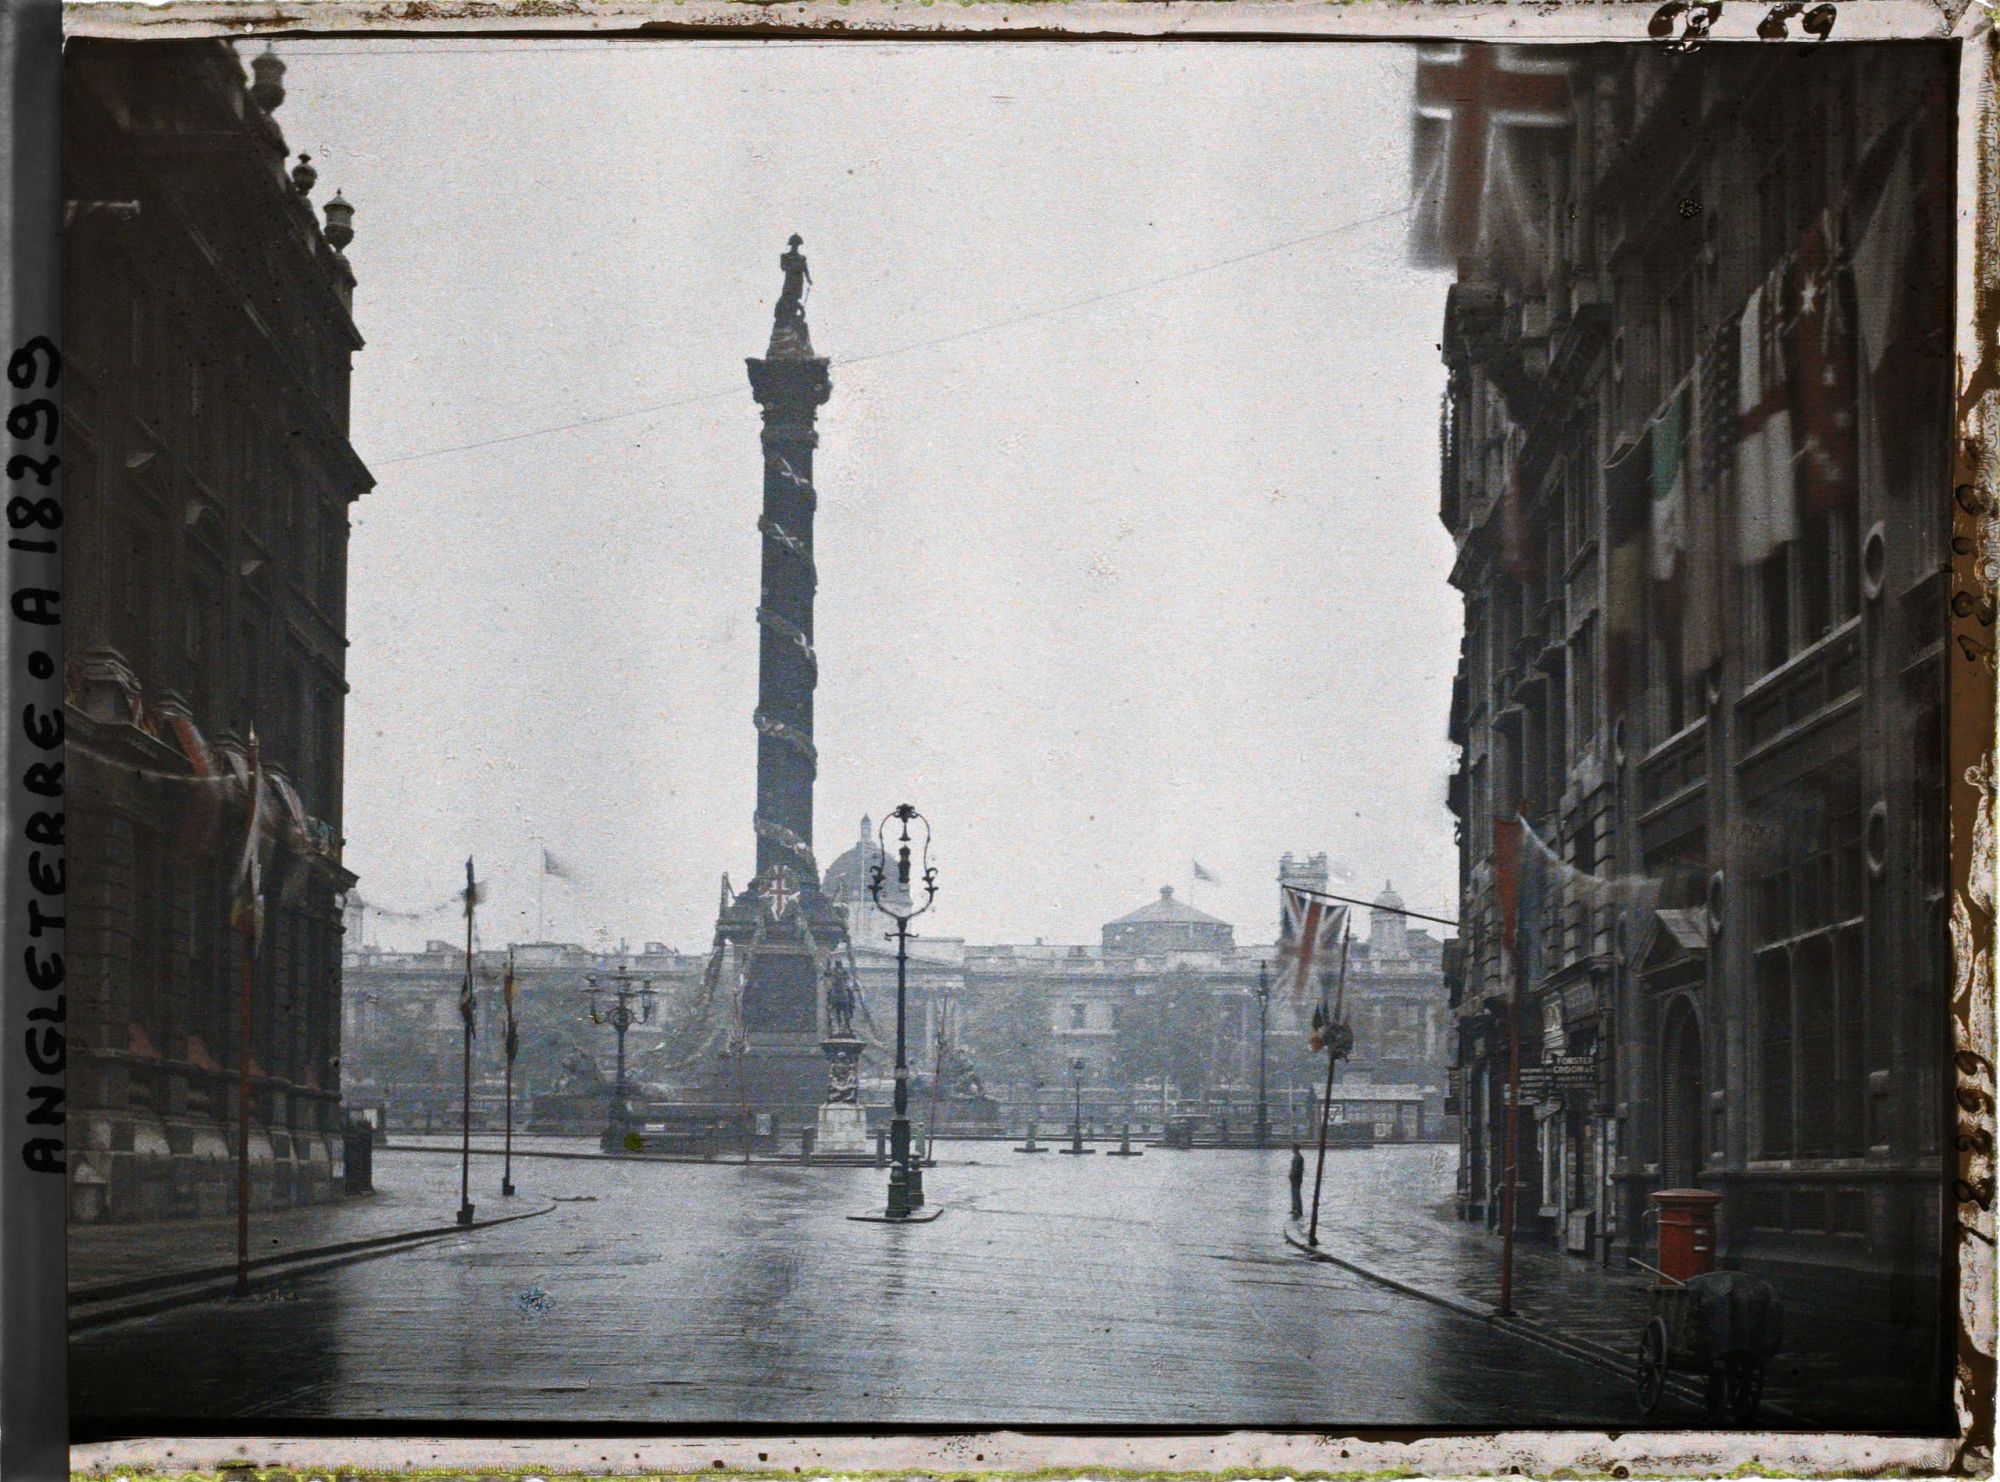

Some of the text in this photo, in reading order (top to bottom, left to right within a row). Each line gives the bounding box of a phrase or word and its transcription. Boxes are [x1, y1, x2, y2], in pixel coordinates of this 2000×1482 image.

[8, 335, 61, 554] 18299
[12, 587, 61, 626] A
[21, 704, 65, 1174] ANGLETERRE
